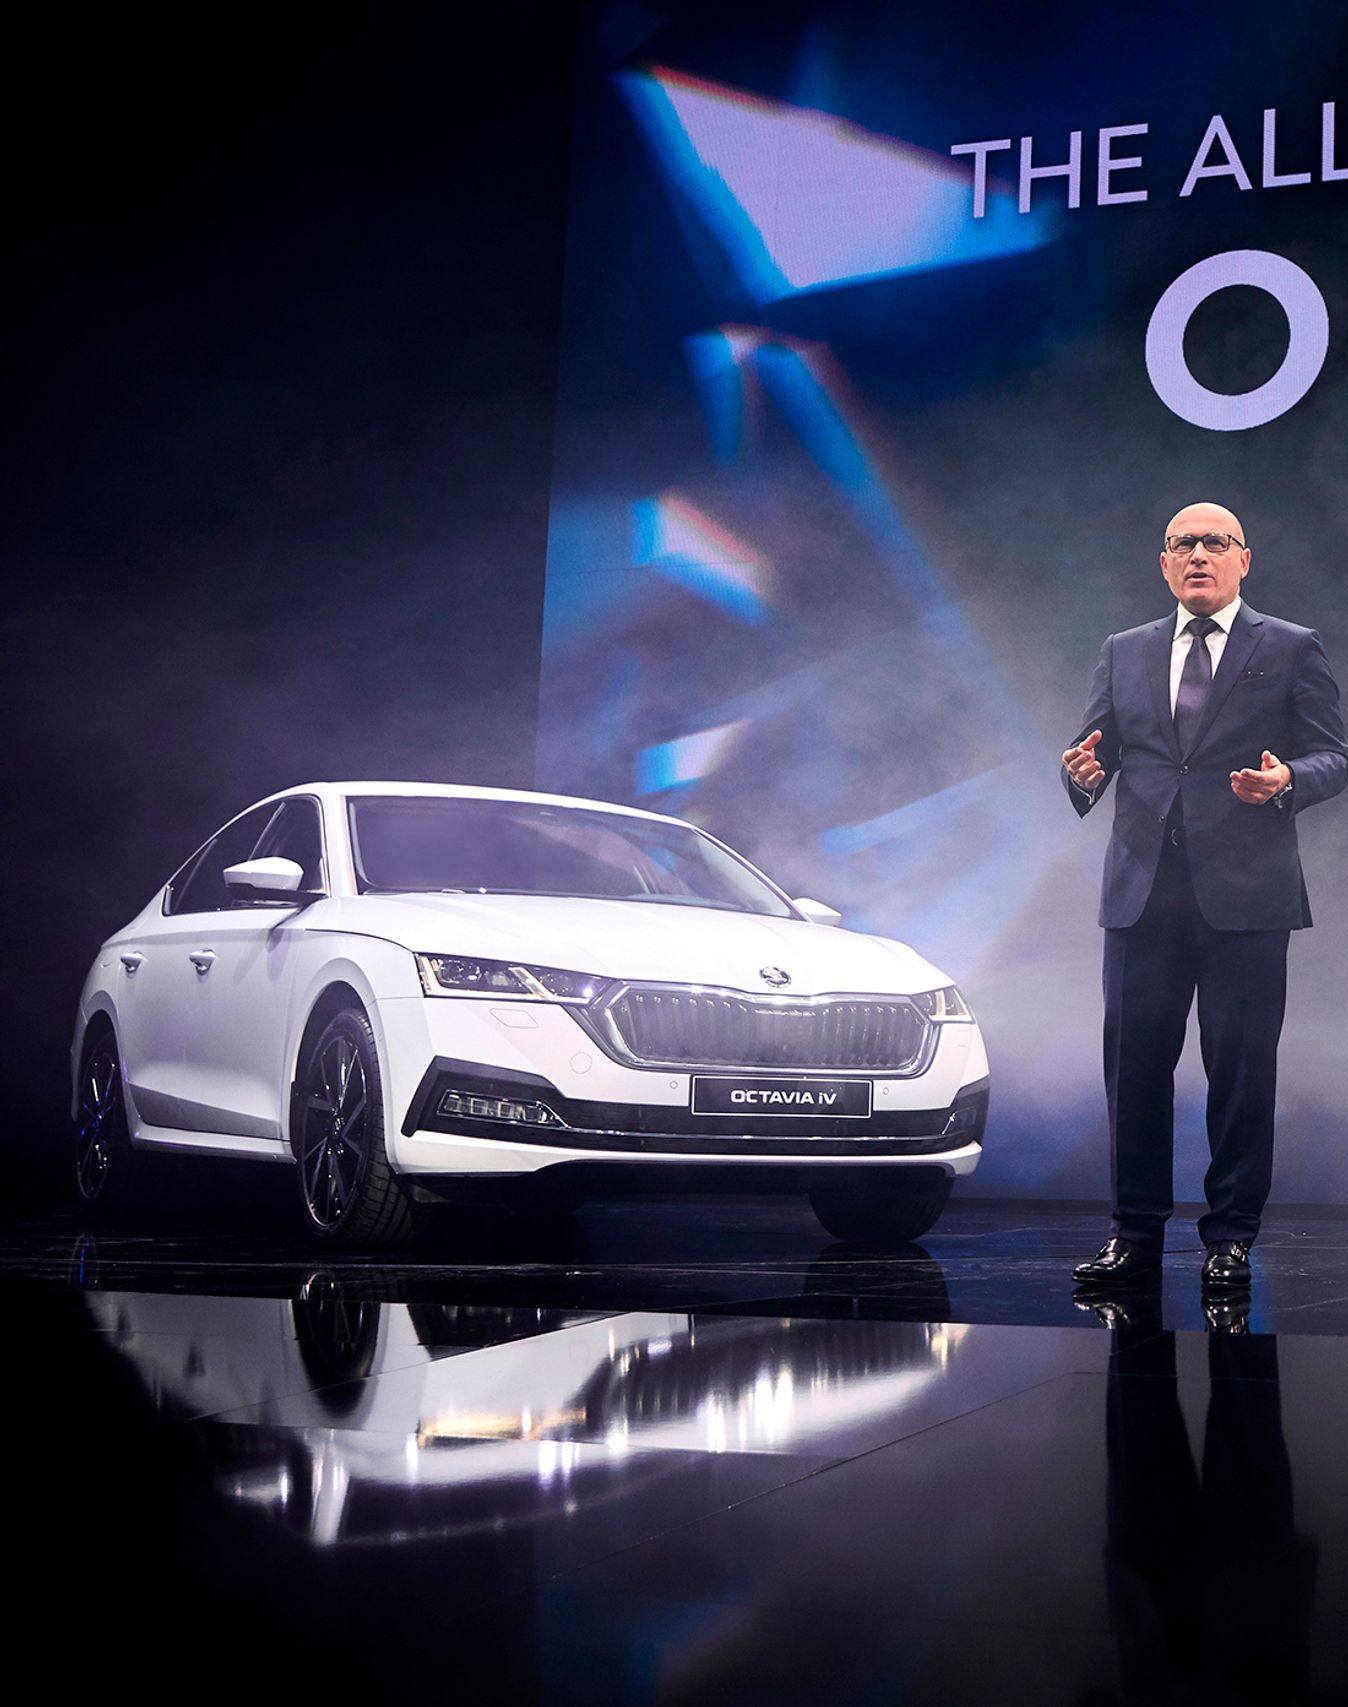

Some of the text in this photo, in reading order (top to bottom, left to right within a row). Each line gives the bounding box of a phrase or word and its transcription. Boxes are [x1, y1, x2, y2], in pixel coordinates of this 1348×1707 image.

[950, 123, 1149, 219] THE
[730, 1089, 837, 1106] OCTAVIA iV
